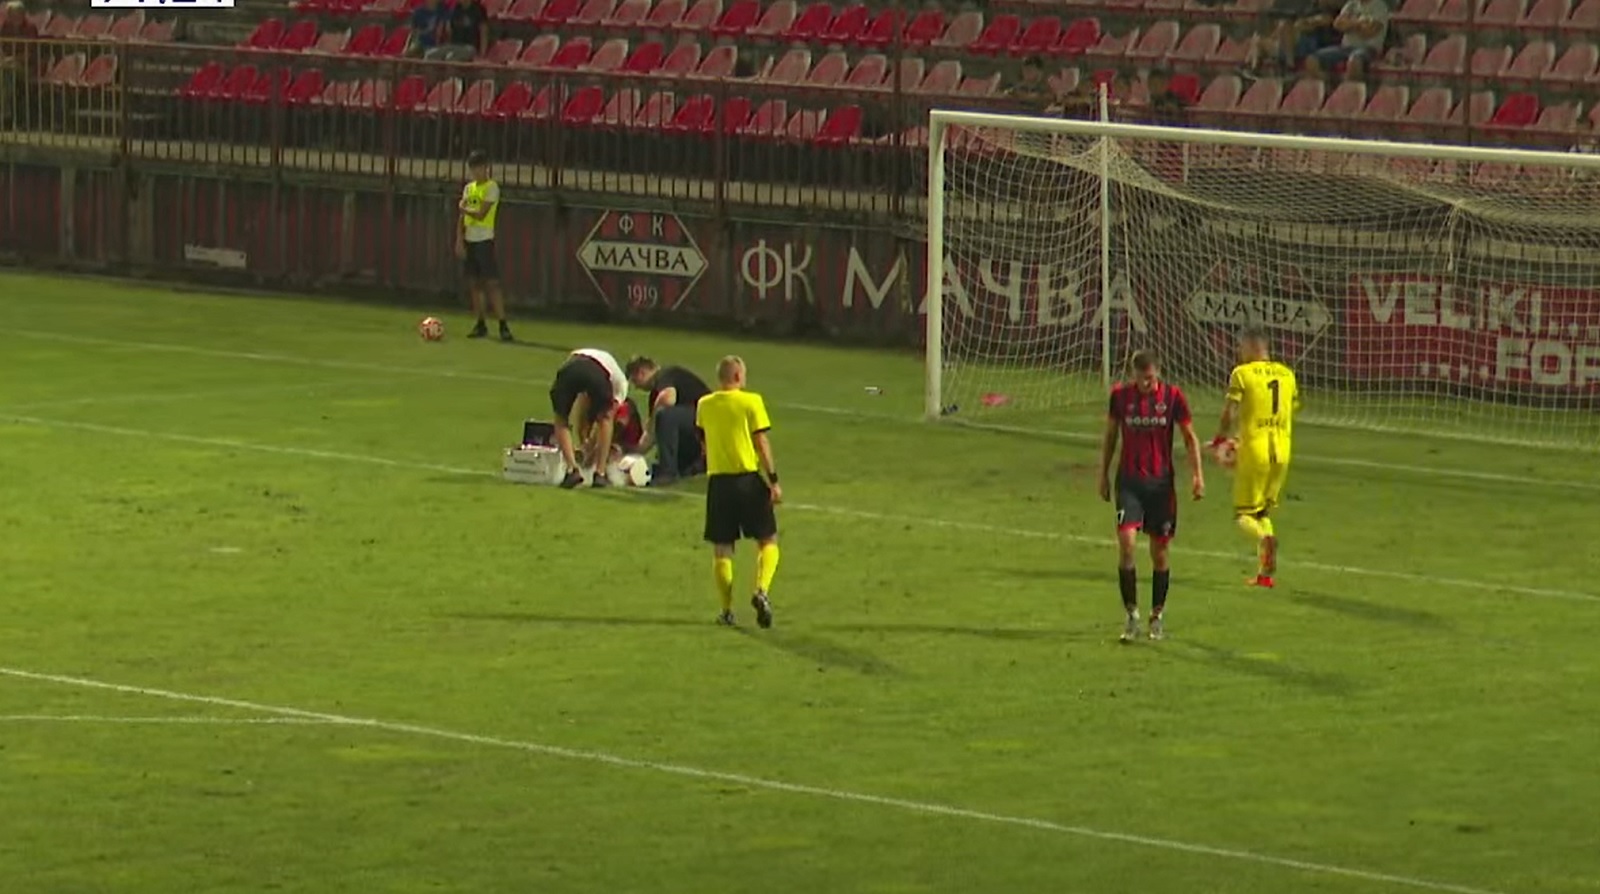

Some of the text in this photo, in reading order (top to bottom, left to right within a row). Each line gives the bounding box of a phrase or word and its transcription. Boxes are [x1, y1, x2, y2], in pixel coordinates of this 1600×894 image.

[619, 214, 664, 236] Ф К
[594, 246, 689, 271] МАЧВА
[628, 284, 657, 308] 1919
[741, 239, 1147, 332] ФК МАЧВА
[1204, 295, 1311, 327] МАЧВА
[1267, 379, 1279, 414] 1
